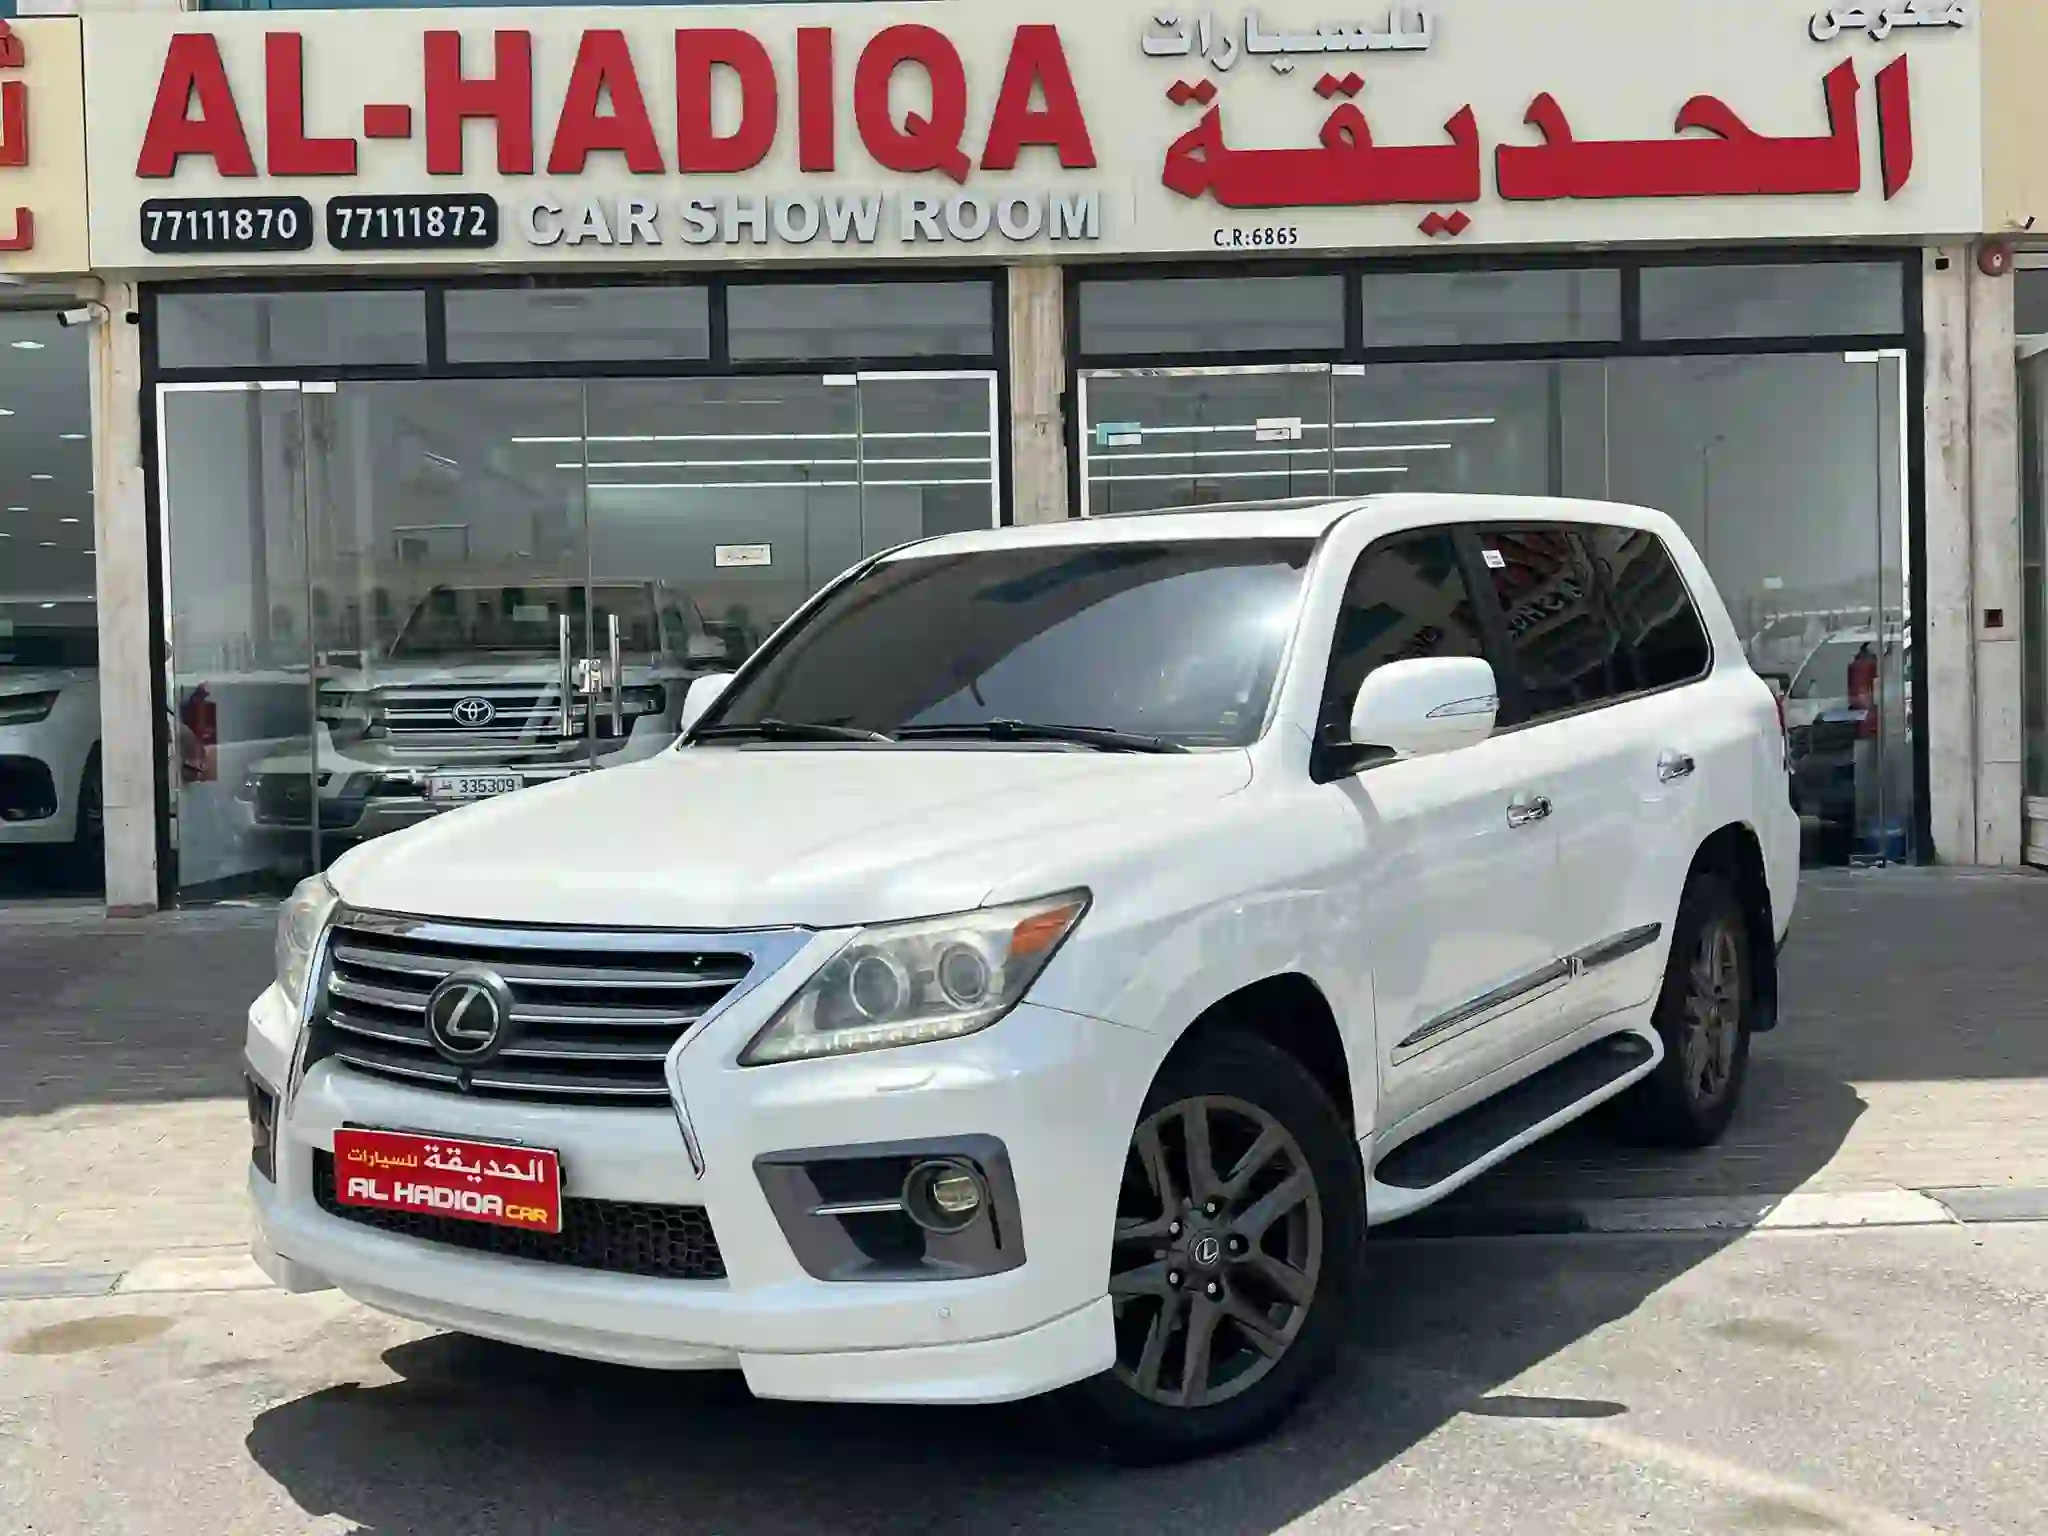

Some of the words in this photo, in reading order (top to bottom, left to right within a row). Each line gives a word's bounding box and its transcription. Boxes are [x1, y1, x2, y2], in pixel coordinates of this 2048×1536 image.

[1141, 6, 1434, 76] للسيارات
[136, 23, 1098, 185] AL-HADIQA
[1162, 52, 1914, 238] الحديقة
[145, 207, 299, 242] 77111870
[335, 205, 489, 240] 77111872
[523, 199, 664, 246] CAR
[680, 194, 883, 245] SHOW
[902, 190, 1101, 243] ROOM
[1213, 226, 1298, 247] C.R:6865
[459, 778, 515, 793] 335309
[347, 1148, 419, 1170] للسيارات
[423, 1143, 545, 1184] الحديقة
[347, 1177, 389, 1201] AL
[393, 1181, 503, 1217] HADIQA
[504, 1204, 549, 1224] CAR
